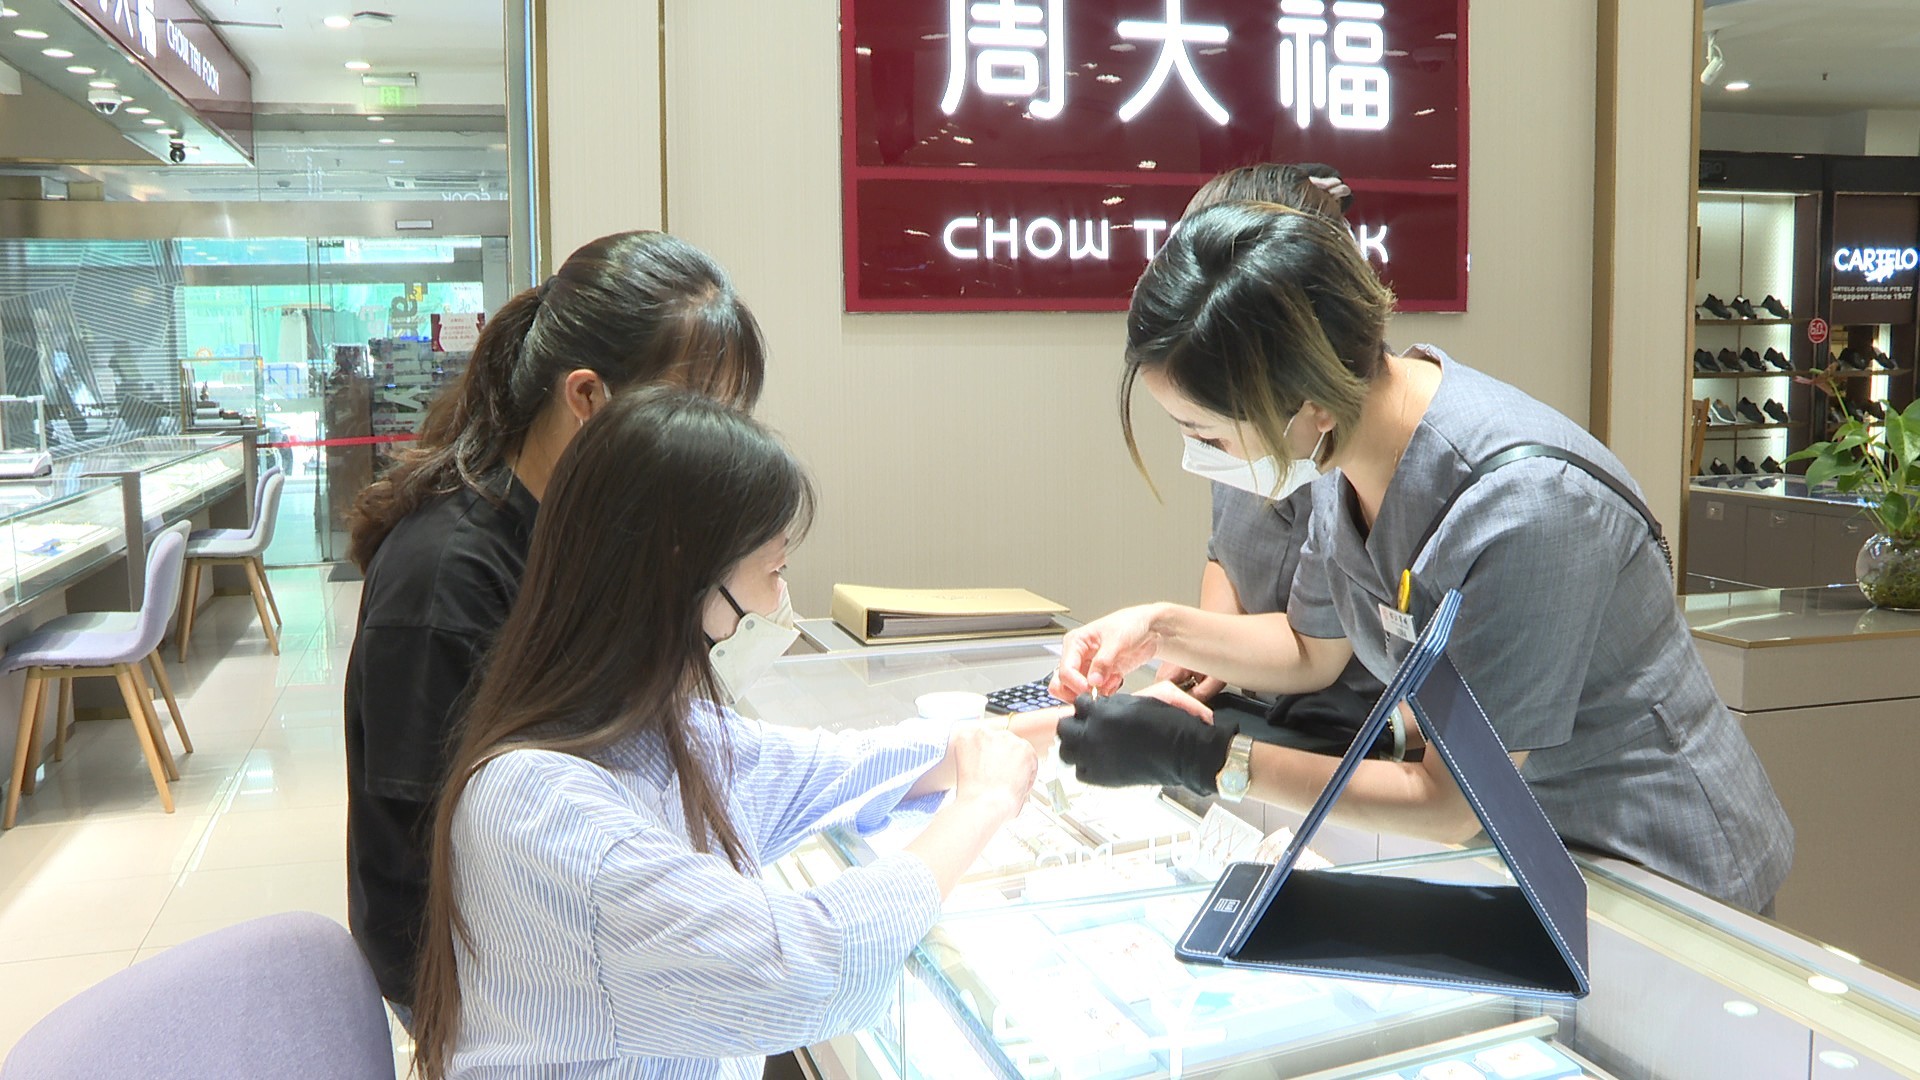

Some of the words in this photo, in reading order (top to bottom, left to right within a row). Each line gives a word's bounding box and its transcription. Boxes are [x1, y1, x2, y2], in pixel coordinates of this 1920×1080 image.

[941, 0, 1391, 130] 周大福
[943, 217, 1110, 260] CHOW
